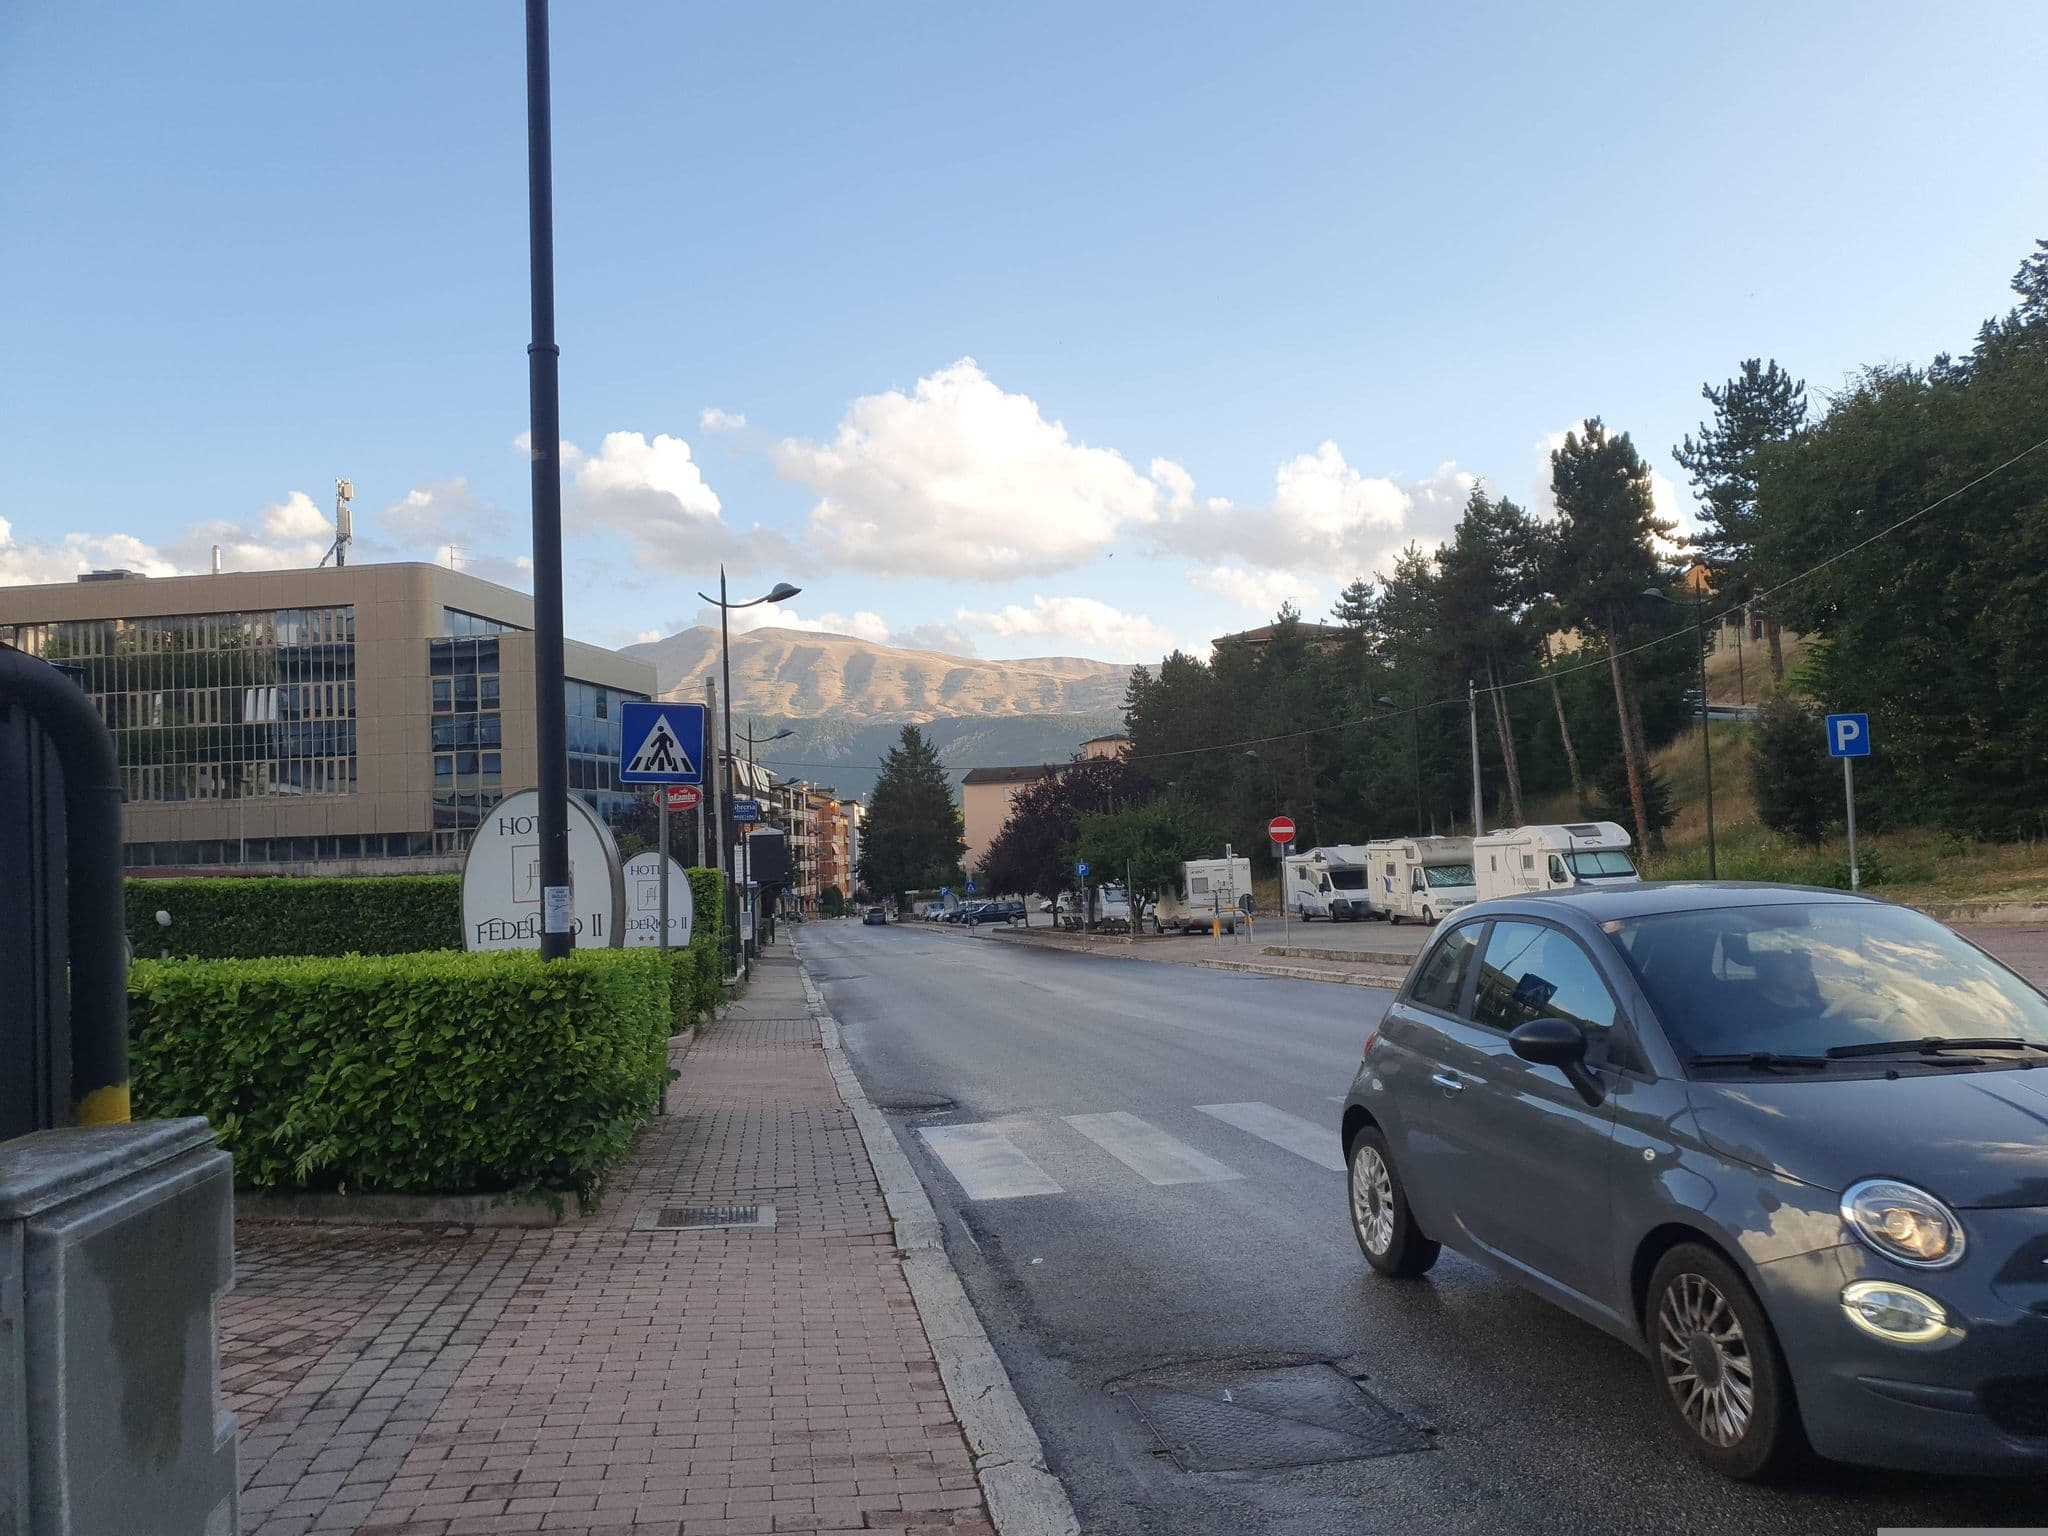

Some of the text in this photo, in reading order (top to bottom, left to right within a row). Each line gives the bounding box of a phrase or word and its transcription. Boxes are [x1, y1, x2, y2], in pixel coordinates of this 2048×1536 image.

[1836, 719, 1860, 751] P
[499, 815, 572, 836] HOT
[630, 864, 672, 876] HOT
[1078, 864, 1086, 874] P
[941, 887, 948, 896] P
[475, 912, 583, 944] FEDER
[592, 913, 603, 936] II
[681, 916, 688, 929] II
